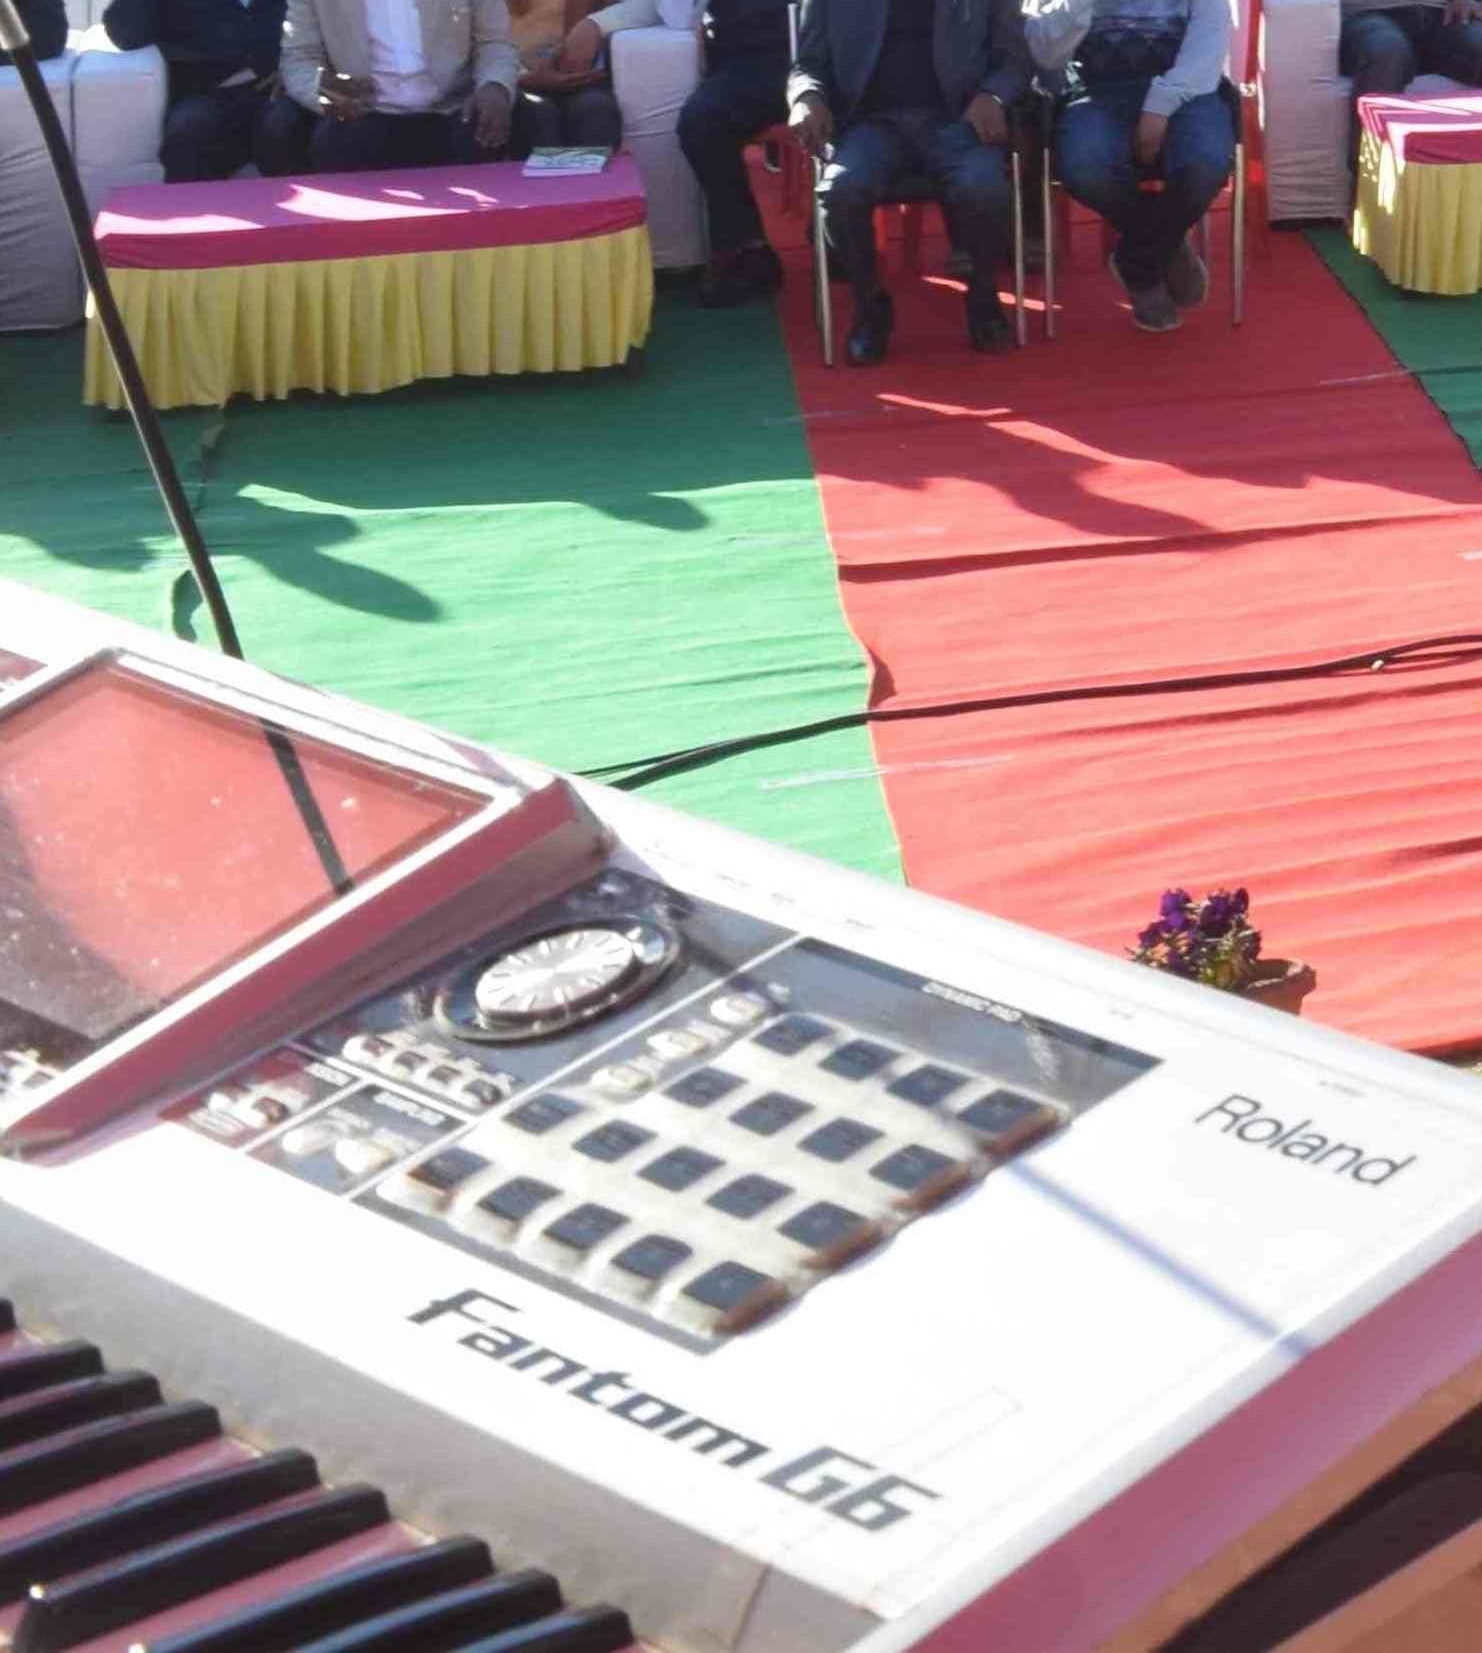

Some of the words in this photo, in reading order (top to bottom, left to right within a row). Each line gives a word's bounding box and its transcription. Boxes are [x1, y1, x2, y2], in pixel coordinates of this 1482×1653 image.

[1193, 1093, 1417, 1185] Roland
[405, 1288, 771, 1468] Fantom
[757, 1445, 943, 1532] G6
